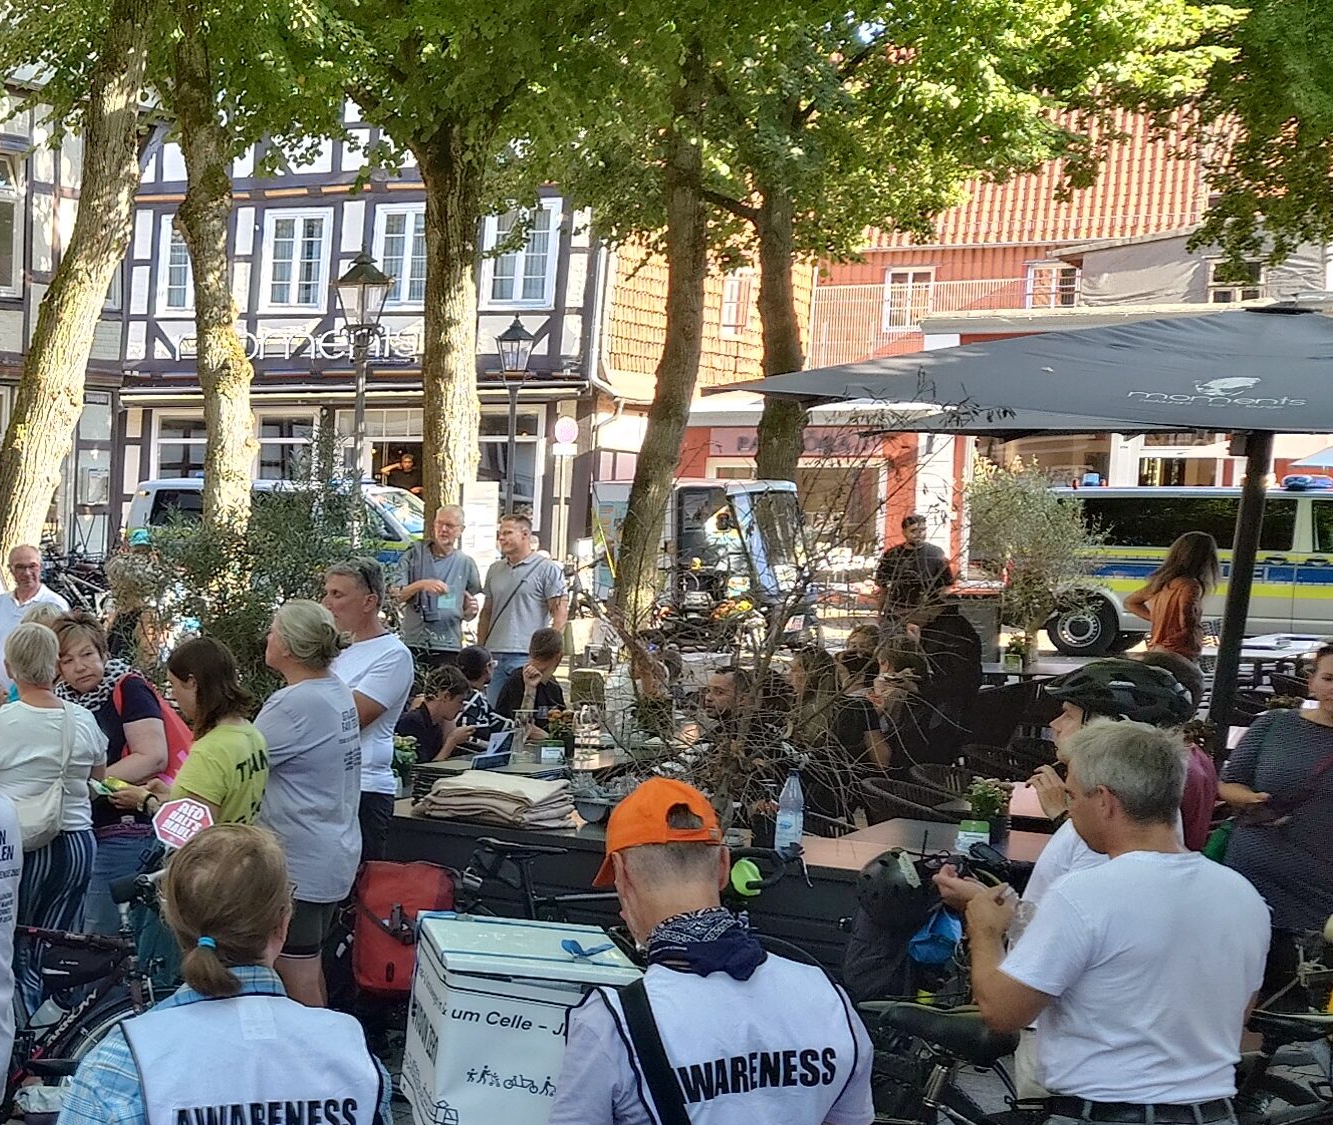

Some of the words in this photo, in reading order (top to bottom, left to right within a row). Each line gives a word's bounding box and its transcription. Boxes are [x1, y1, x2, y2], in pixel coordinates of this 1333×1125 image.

[1127, 391, 1307, 406] moments
[451, 1008, 481, 1023] um
[485, 1011, 533, 1031] Celle
[552, 1023, 566, 1037] J
[677, 1047, 837, 1105] WARENESS
